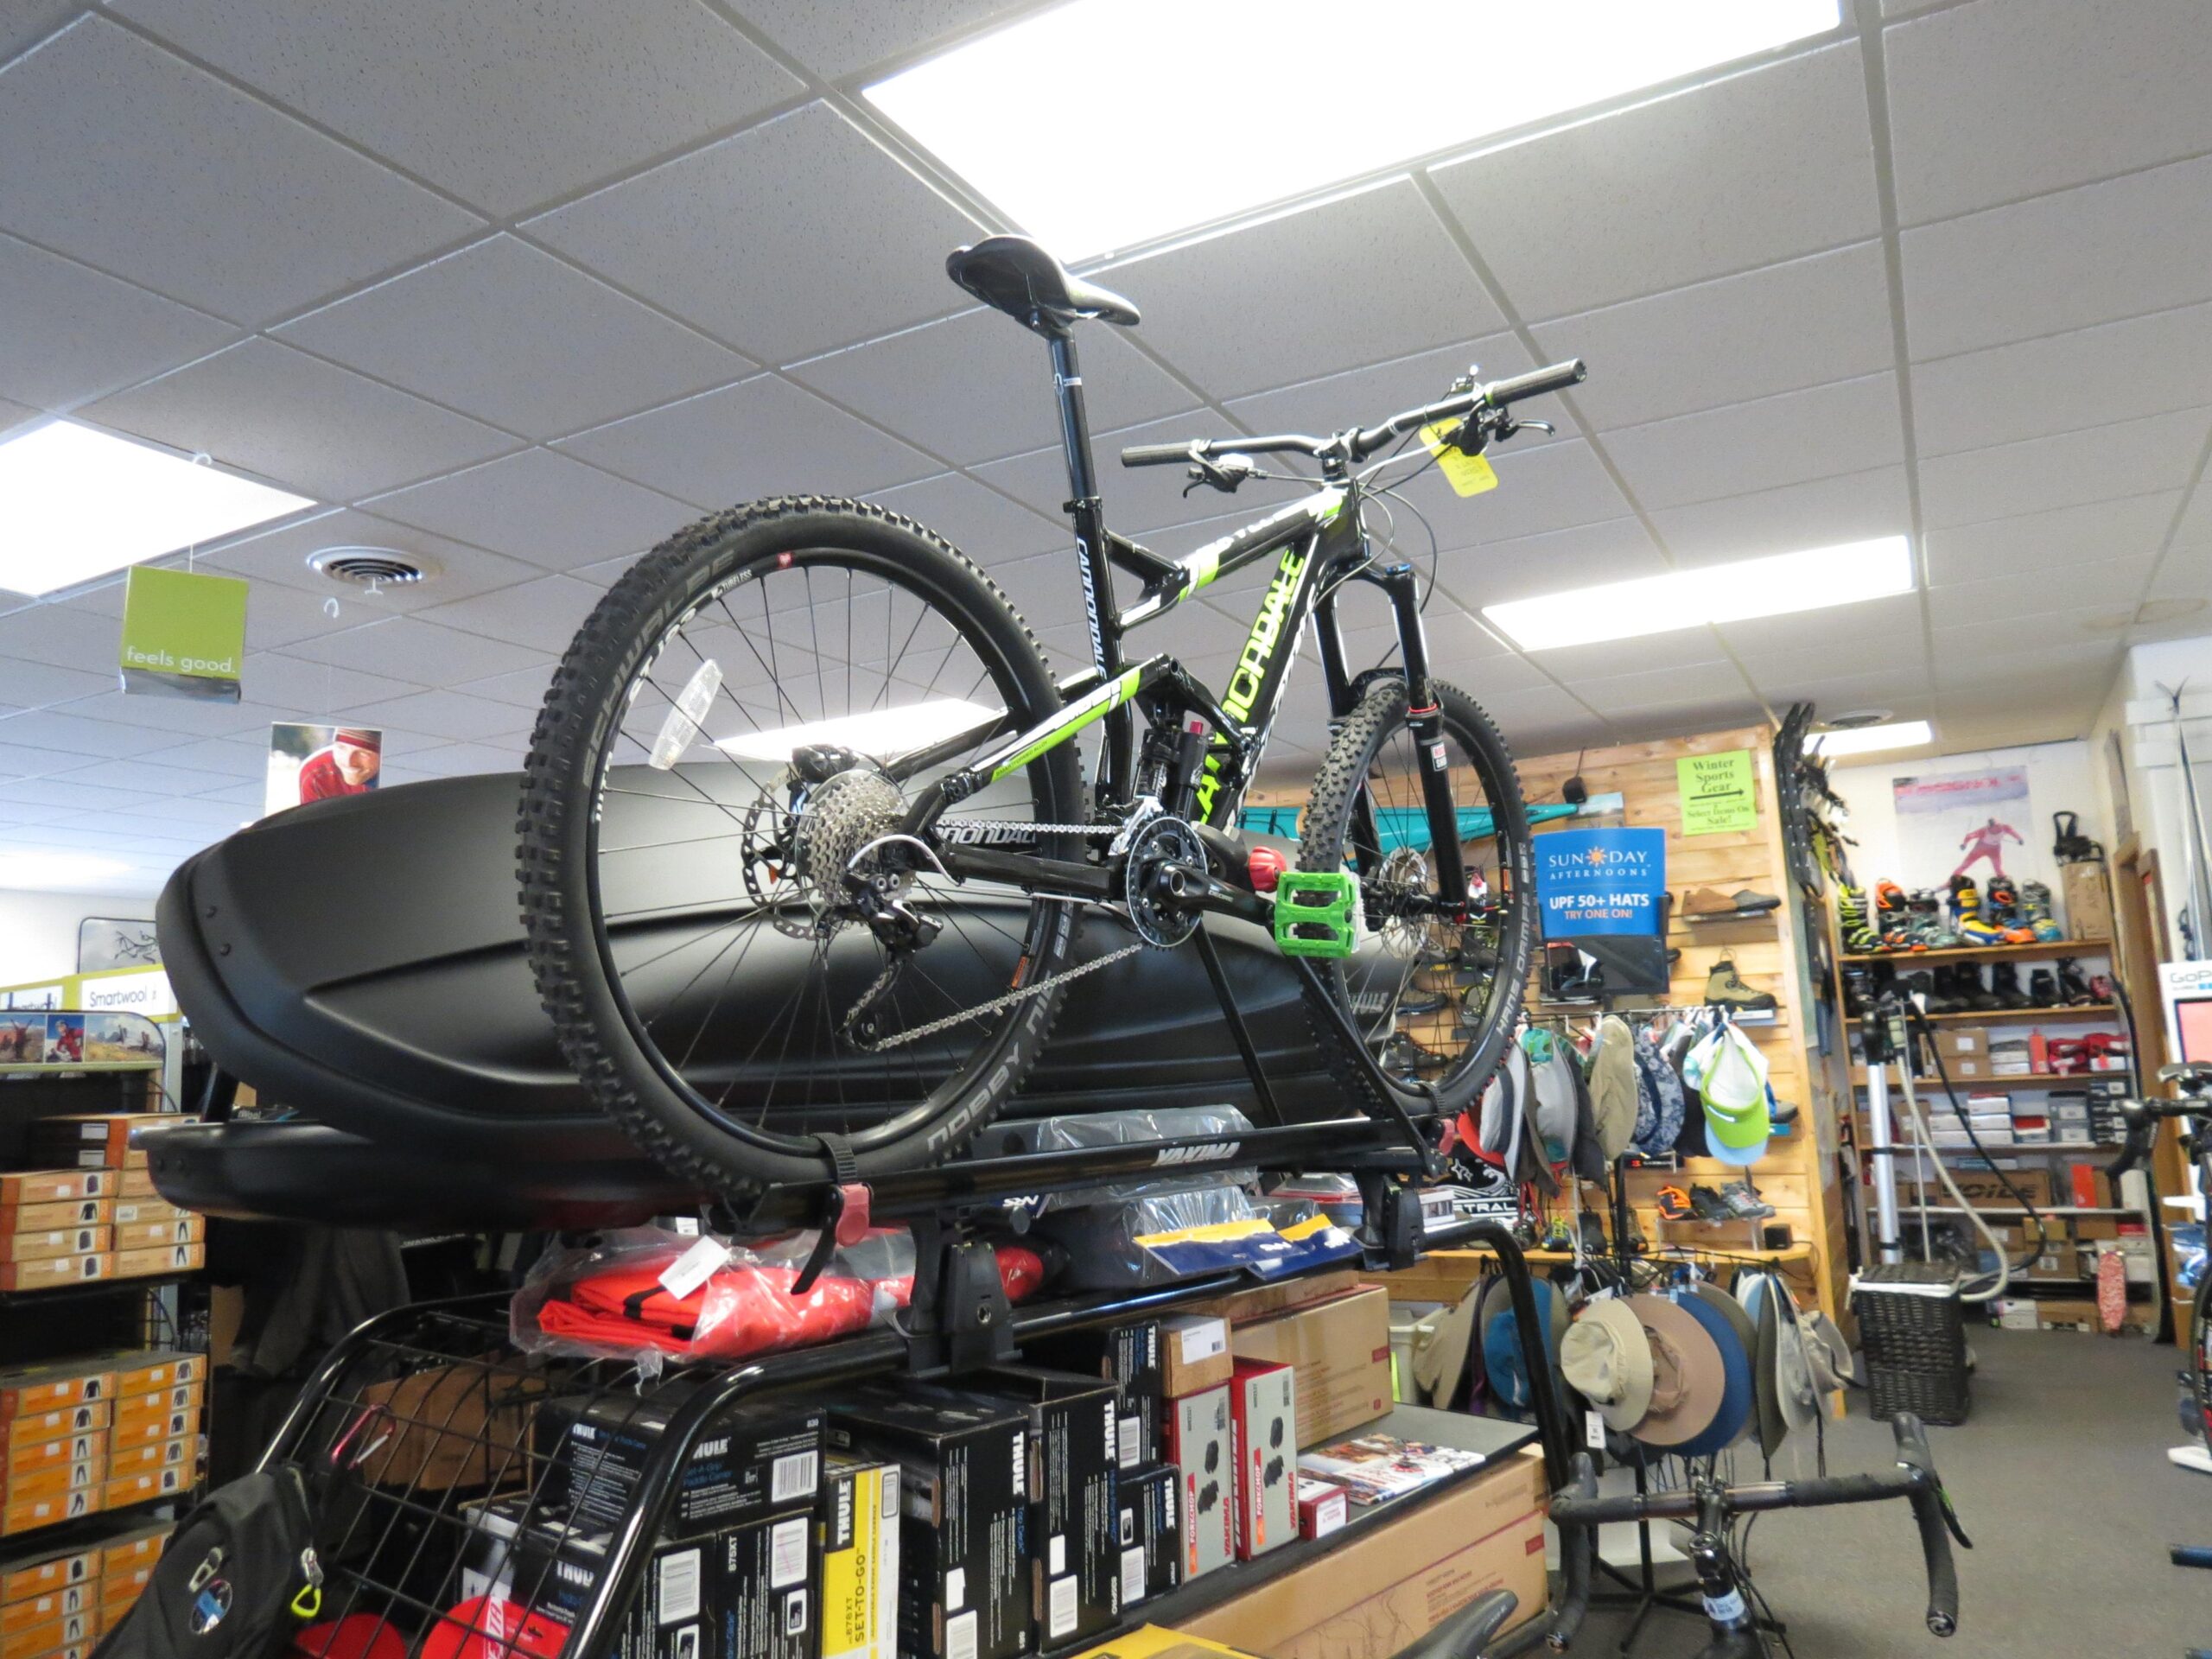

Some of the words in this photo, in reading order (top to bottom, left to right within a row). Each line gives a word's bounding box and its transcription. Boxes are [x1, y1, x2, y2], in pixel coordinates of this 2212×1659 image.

[127, 645, 174, 666] feels
[181, 657, 236, 672] good.
[1693, 760, 1735, 771] Winter
[1695, 771, 1734, 785] Sports
[1701, 782, 1732, 793] Gear
[1548, 853, 1584, 868] SUN
[1610, 850, 1648, 863] DAY
[1549, 868, 1647, 880] AFTERNOONS
[1549, 895, 1575, 910] UPF
[1578, 894, 1605, 907] 50+
[1609, 893, 1649, 906] HATS
[1565, 910, 1583, 920] TRY
[1585, 909, 1609, 918] ONE
[1611, 909, 1633, 918] ON!
[90, 990, 148, 1007] Smartwool
[1147, 1325, 1156, 1369] THULE
[1104, 1400, 1116, 1462] THULE
[693, 1438, 728, 1459] HULE
[1013, 1432, 1025, 1497] THULE
[1165, 1477, 1175, 1529] THULE
[1287, 1471, 1296, 1530] YAKIMA
[838, 1478, 852, 1545] THULE
